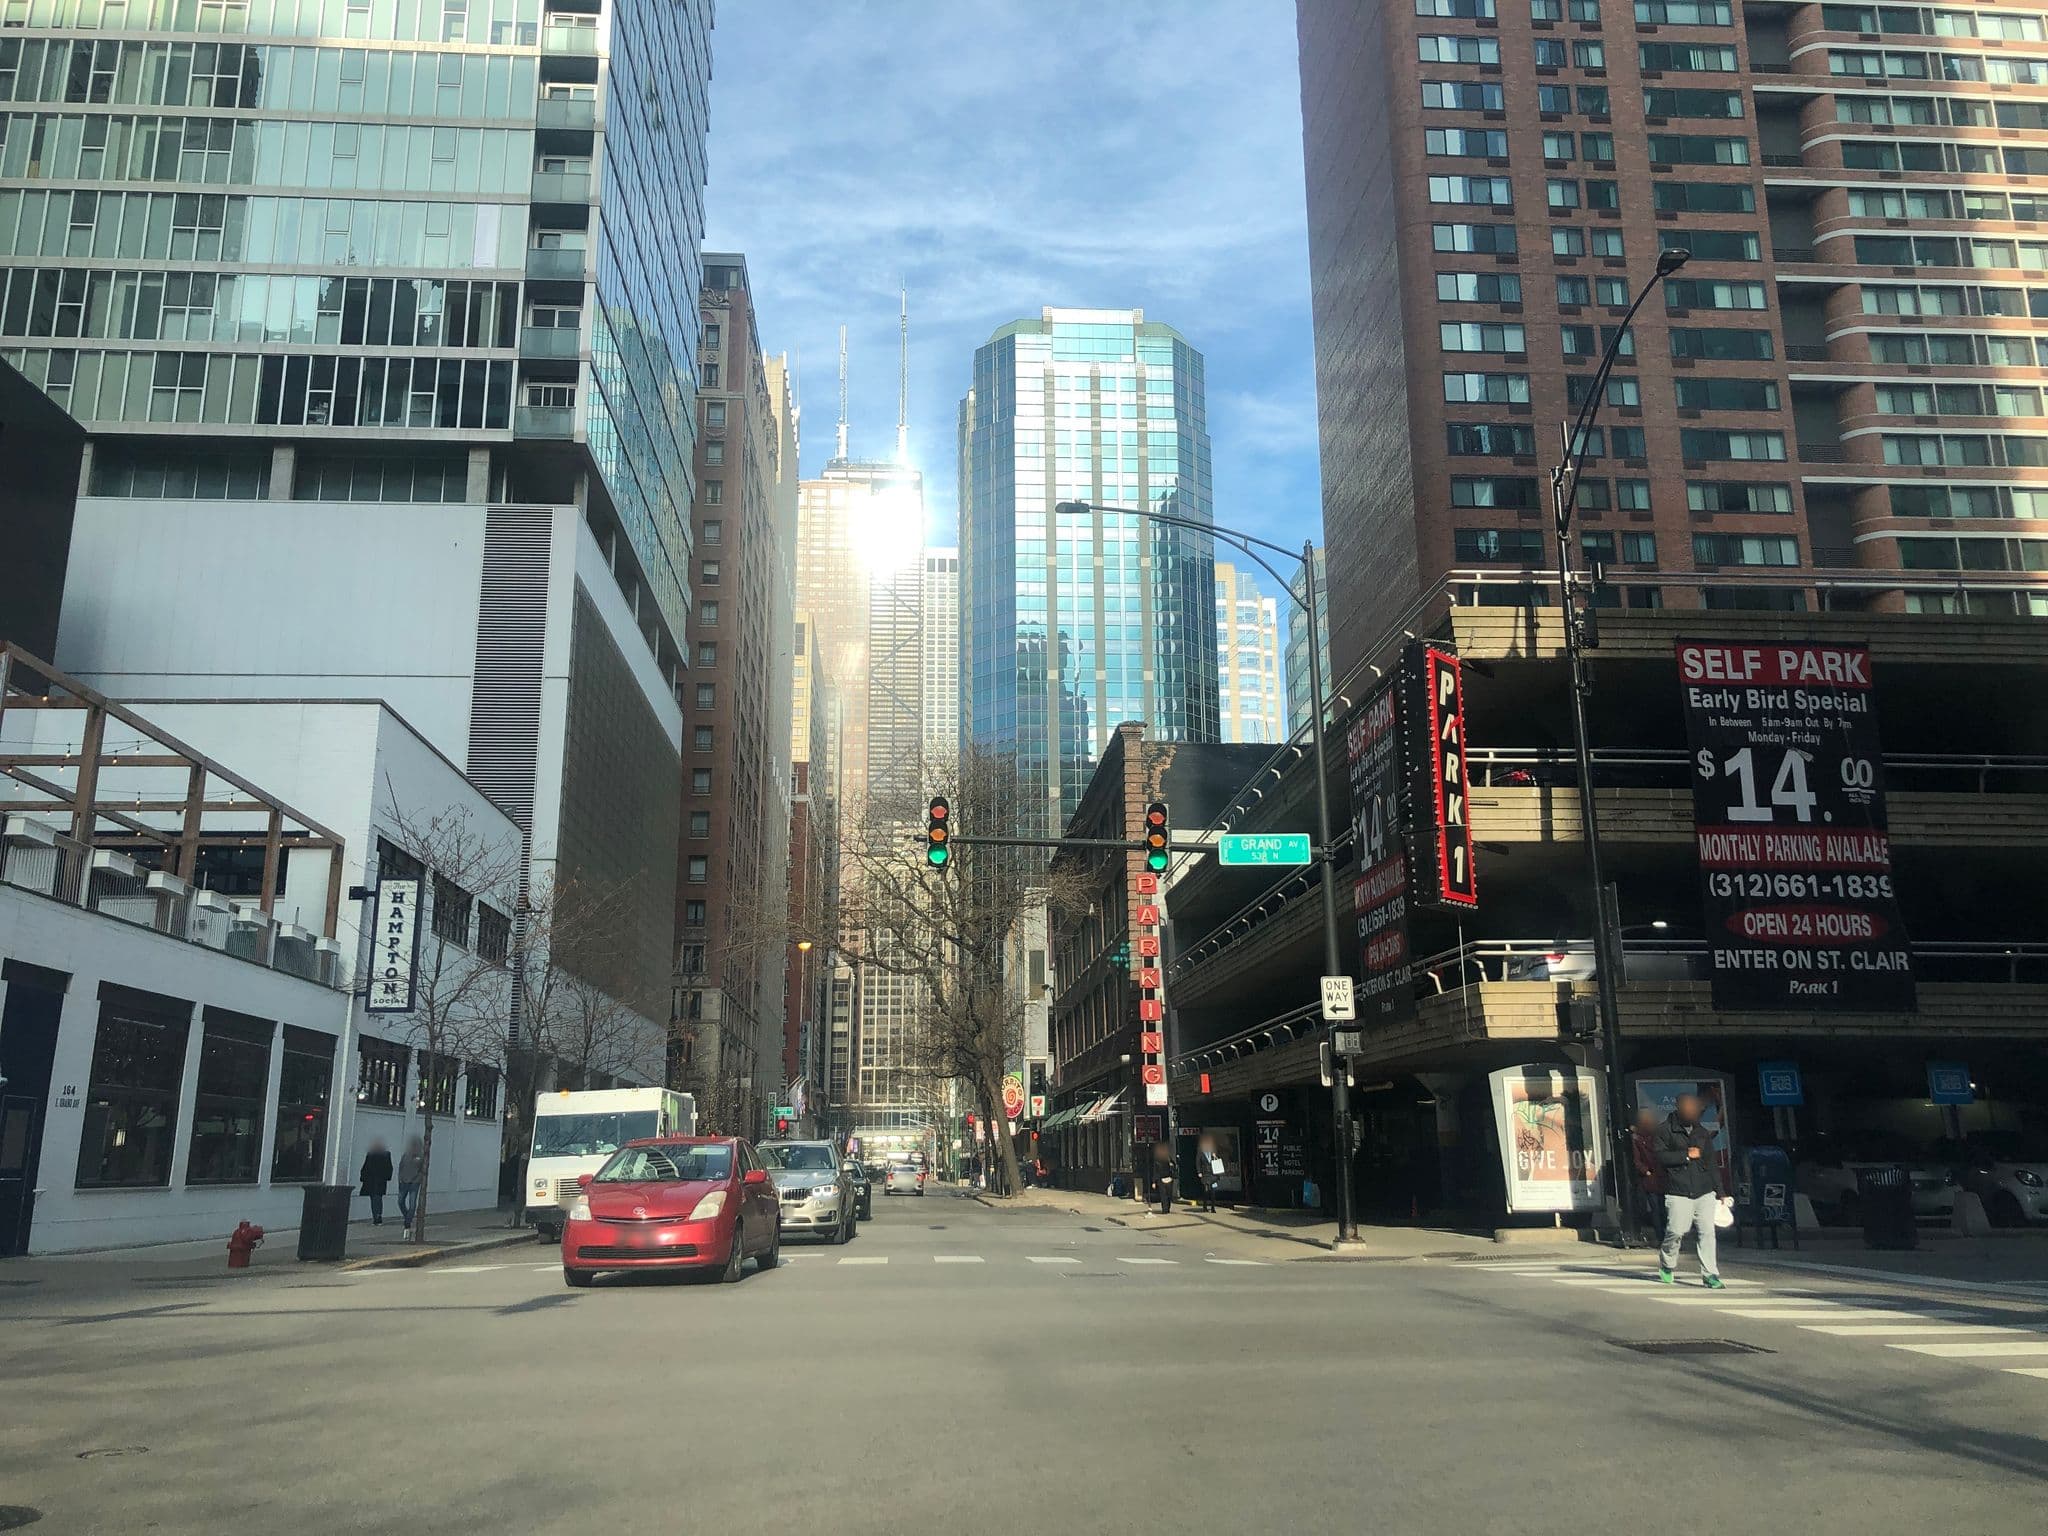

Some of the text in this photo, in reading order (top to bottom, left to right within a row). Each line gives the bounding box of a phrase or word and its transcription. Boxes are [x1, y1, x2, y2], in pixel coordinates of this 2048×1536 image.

[1682, 648, 1868, 684] SELF PARK
[1689, 688, 1867, 714] Early Bird Special
[1748, 731, 1785, 744] Monday
[1791, 731, 1821, 745] Friday
[1439, 670, 1464, 884] PARK 1
[1241, 838, 1282, 850] GRAND
[1699, 834, 1761, 861] MONTHLY
[1765, 835, 1822, 862] PARKING
[1272, 851, 1279, 860] N
[1708, 872, 1894, 898] (312)661-1839
[1744, 913, 1873, 937] OPEN 24 HOURS
[383, 891, 405, 994] HAMPTON
[1714, 950, 1910, 970] ENTER ON ST. CLAIR
[1138, 877, 1161, 1083] PARKING
[1325, 981, 1348, 990] ONE
[1832, 980, 1839, 994] 1
[1326, 992, 1349, 1001] WAY
[63, 1085, 76, 1095] 164
